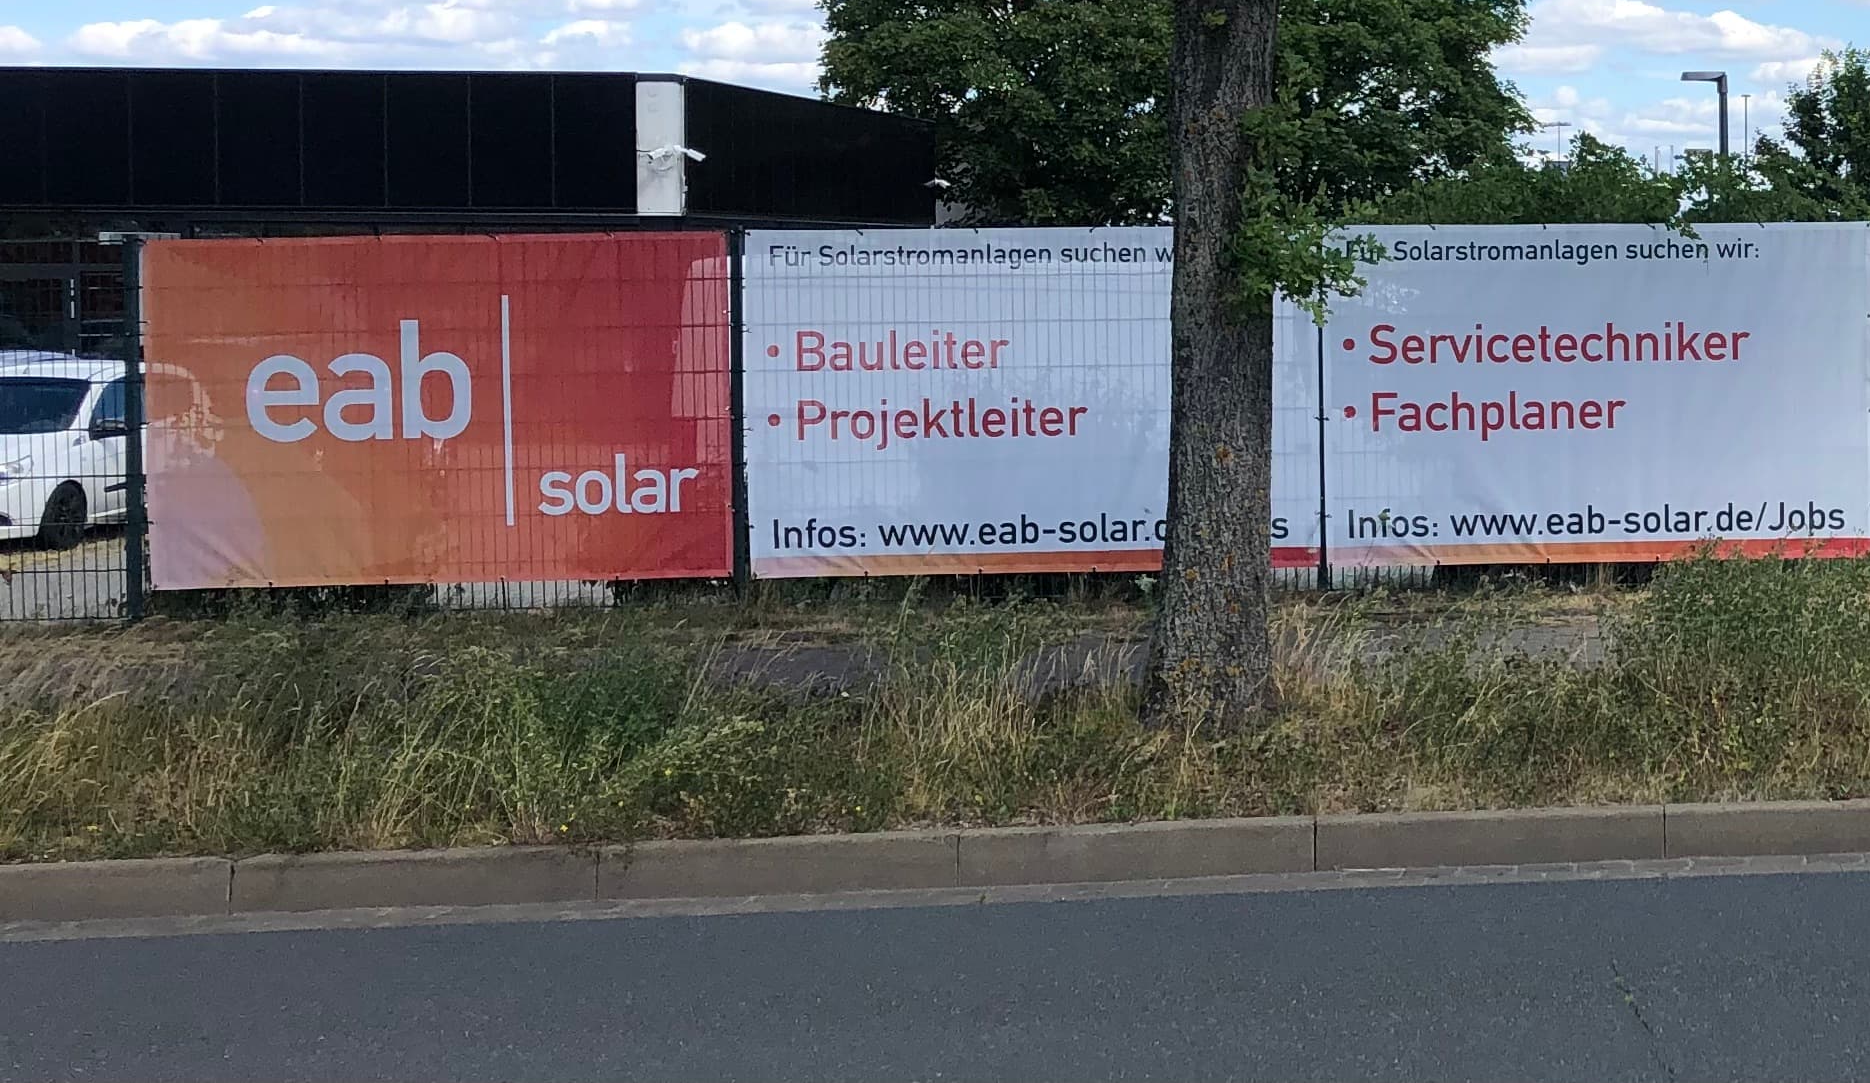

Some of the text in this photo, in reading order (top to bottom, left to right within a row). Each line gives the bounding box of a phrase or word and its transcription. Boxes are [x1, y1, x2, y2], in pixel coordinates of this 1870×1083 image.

[770, 245, 811, 266] Für
[818, 242, 1053, 270] Solarstromanlagen
[1060, 242, 1146, 263] suchen
[1393, 239, 1618, 266] Solarstromanlagen
[1625, 237, 1709, 260] suchen
[1715, 237, 1760, 259] wir:
[796, 329, 1010, 372] Bauleiter
[1368, 321, 1751, 365] Servicetechniker
[246, 320, 472, 443] eab
[797, 396, 1089, 451] Projektleiter
[1371, 390, 1627, 442] Fachplaner
[538, 453, 700, 516] solar
[773, 517, 866, 550] Infos:
[1348, 501, 1845, 539] Infos: www.eab-solar.de/Jobs
